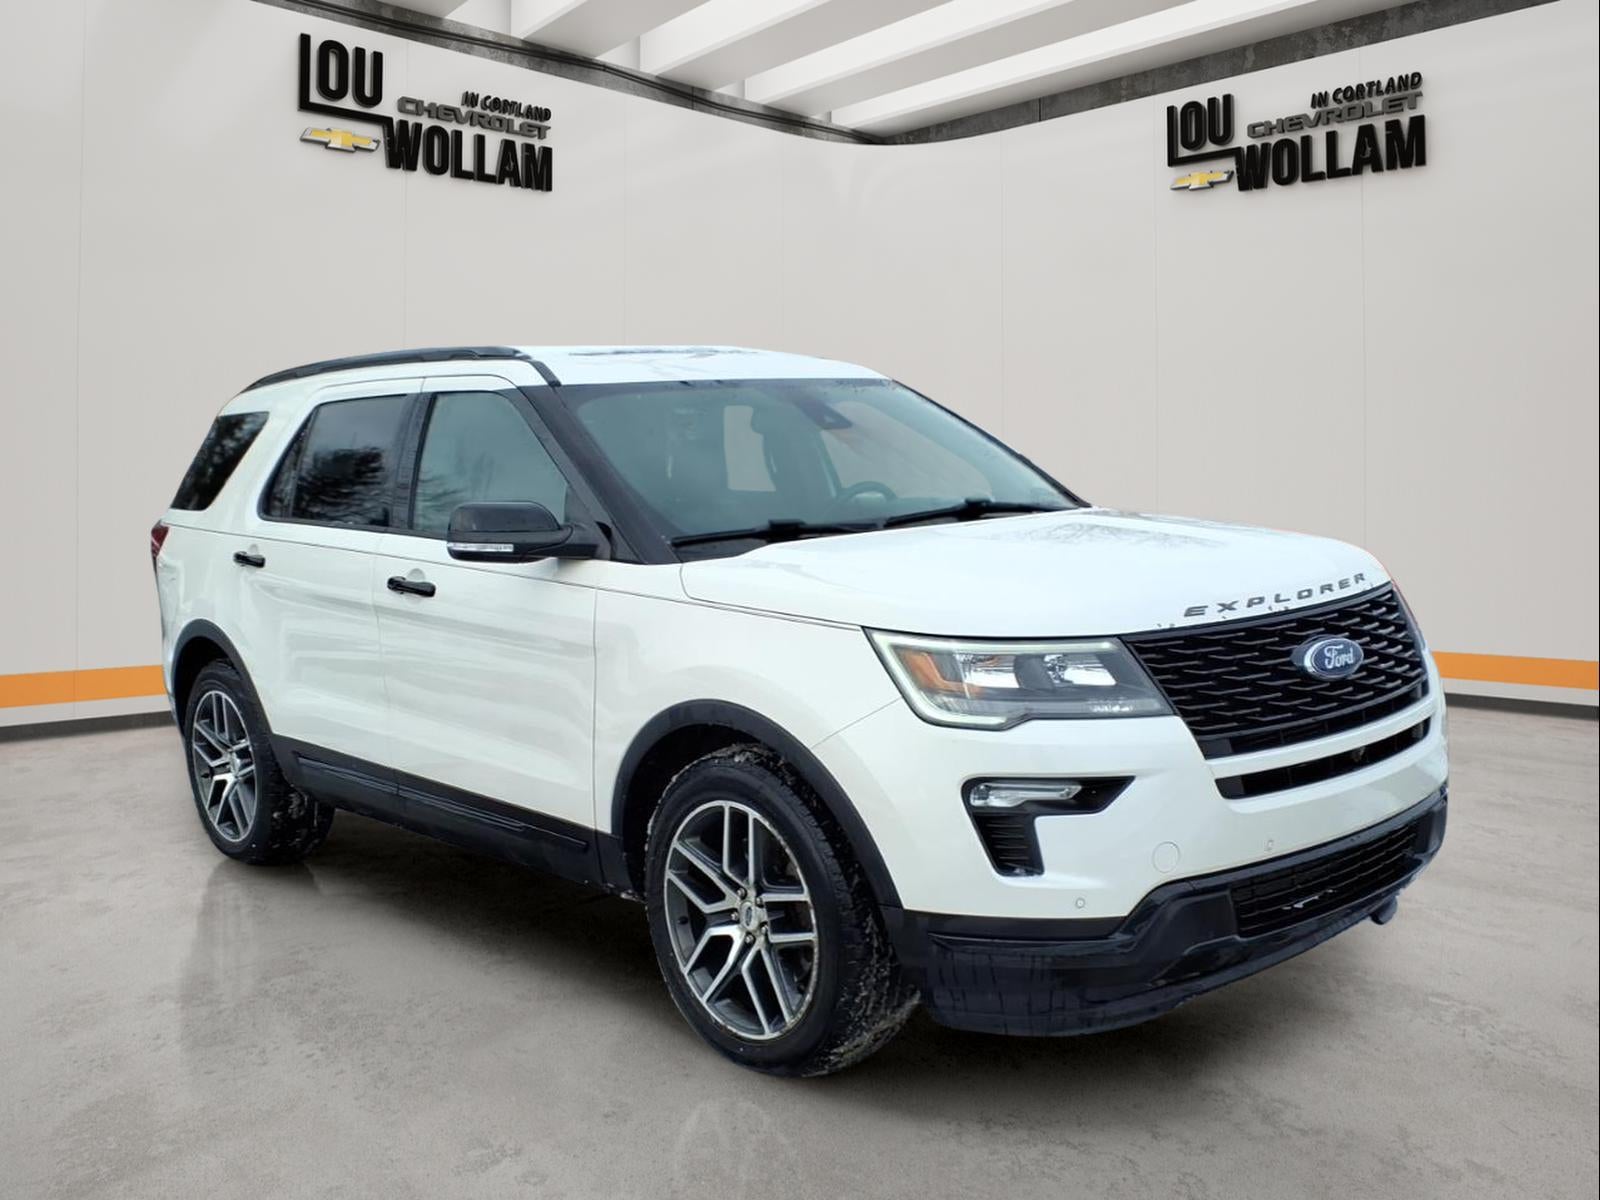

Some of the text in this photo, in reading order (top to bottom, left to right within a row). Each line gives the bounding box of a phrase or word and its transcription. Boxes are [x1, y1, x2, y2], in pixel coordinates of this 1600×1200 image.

[298, 33, 384, 111] LOU
[1310, 72, 1422, 109] IN CORTLAND
[397, 96, 551, 140] CHEVROLET
[461, 91, 552, 122] IN CORTLAND
[1247, 91, 1423, 139] CHEVROLET
[1167, 94, 1235, 167] LOU
[1236, 114, 1427, 192] WOLLAM
[384, 118, 553, 192] WOLLAM
[1183, 572, 1366, 618] EXPLORER
[1324, 644, 1354, 670] Ford
